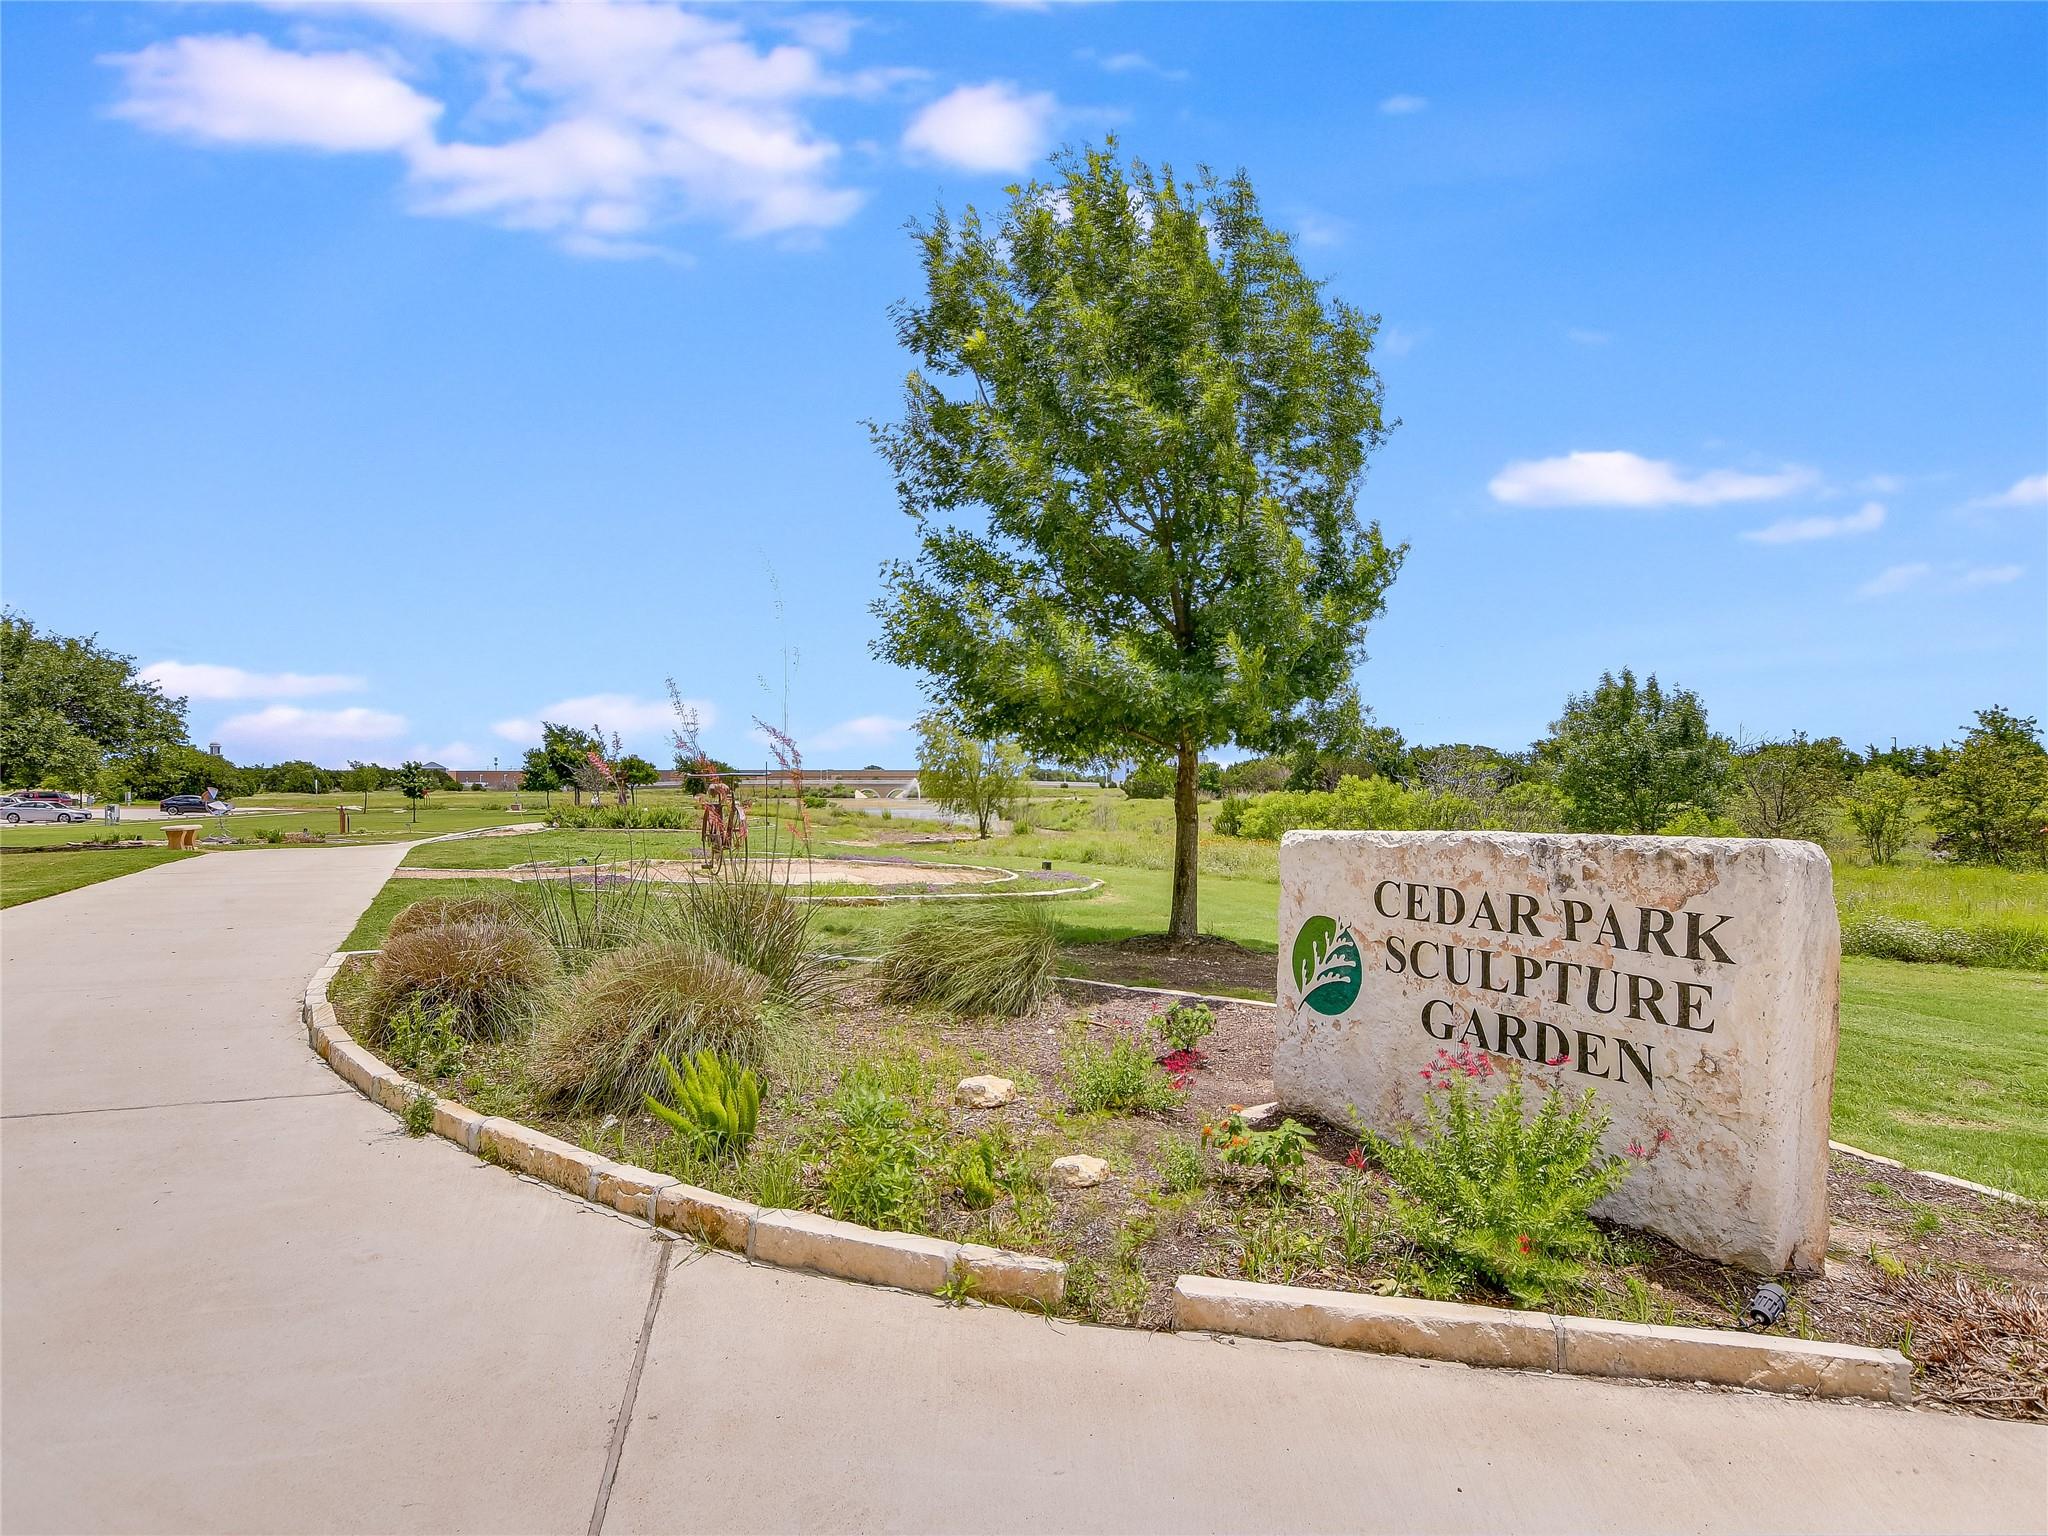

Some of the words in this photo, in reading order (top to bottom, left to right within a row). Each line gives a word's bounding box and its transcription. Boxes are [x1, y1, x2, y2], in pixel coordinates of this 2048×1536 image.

[1374, 879, 1544, 938] CEDAR
[1559, 898, 1736, 965] PARK
[1385, 936, 1715, 1034] SCULPTURE
[1421, 999, 1655, 1090] GARDEN
